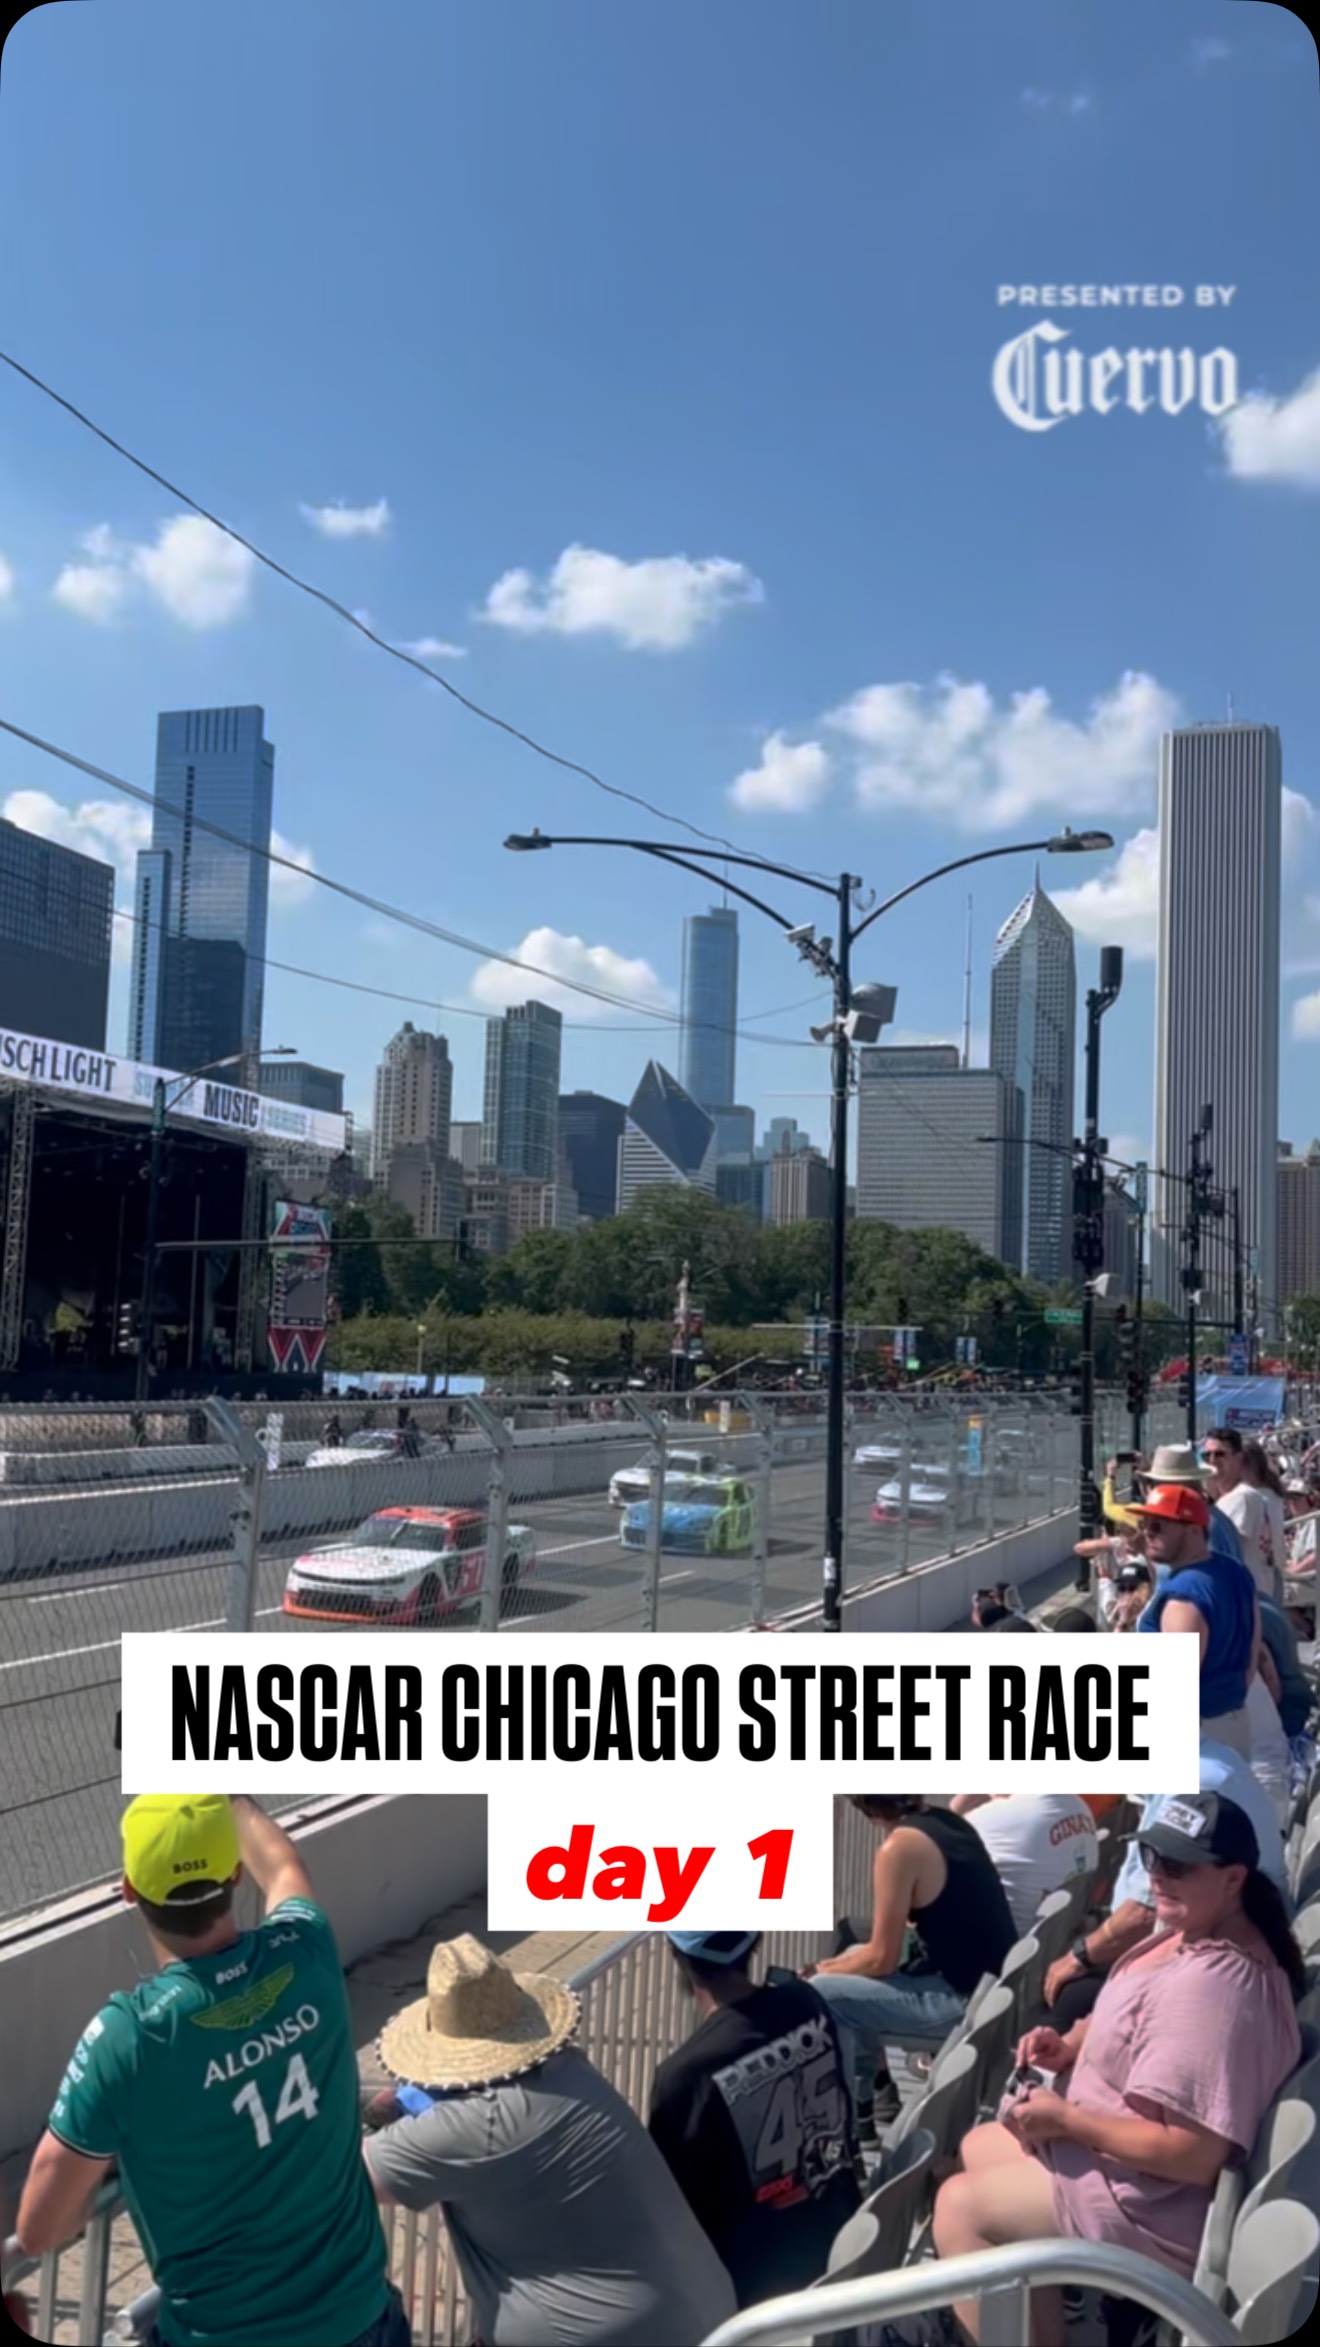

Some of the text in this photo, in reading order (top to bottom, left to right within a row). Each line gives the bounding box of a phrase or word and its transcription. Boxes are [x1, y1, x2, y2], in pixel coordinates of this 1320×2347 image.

[0, 1032, 47, 1078] SCH
[50, 1046, 117, 1092] LIGHT
[203, 1082, 260, 1129] MUSIC
[173, 1859, 208, 1874] BOSS
[215, 1962, 248, 1985] BOSS
[204, 2003, 320, 2089] ALONSO
[232, 2052, 320, 2149] 14
[755, 2050, 843, 2176] 45
